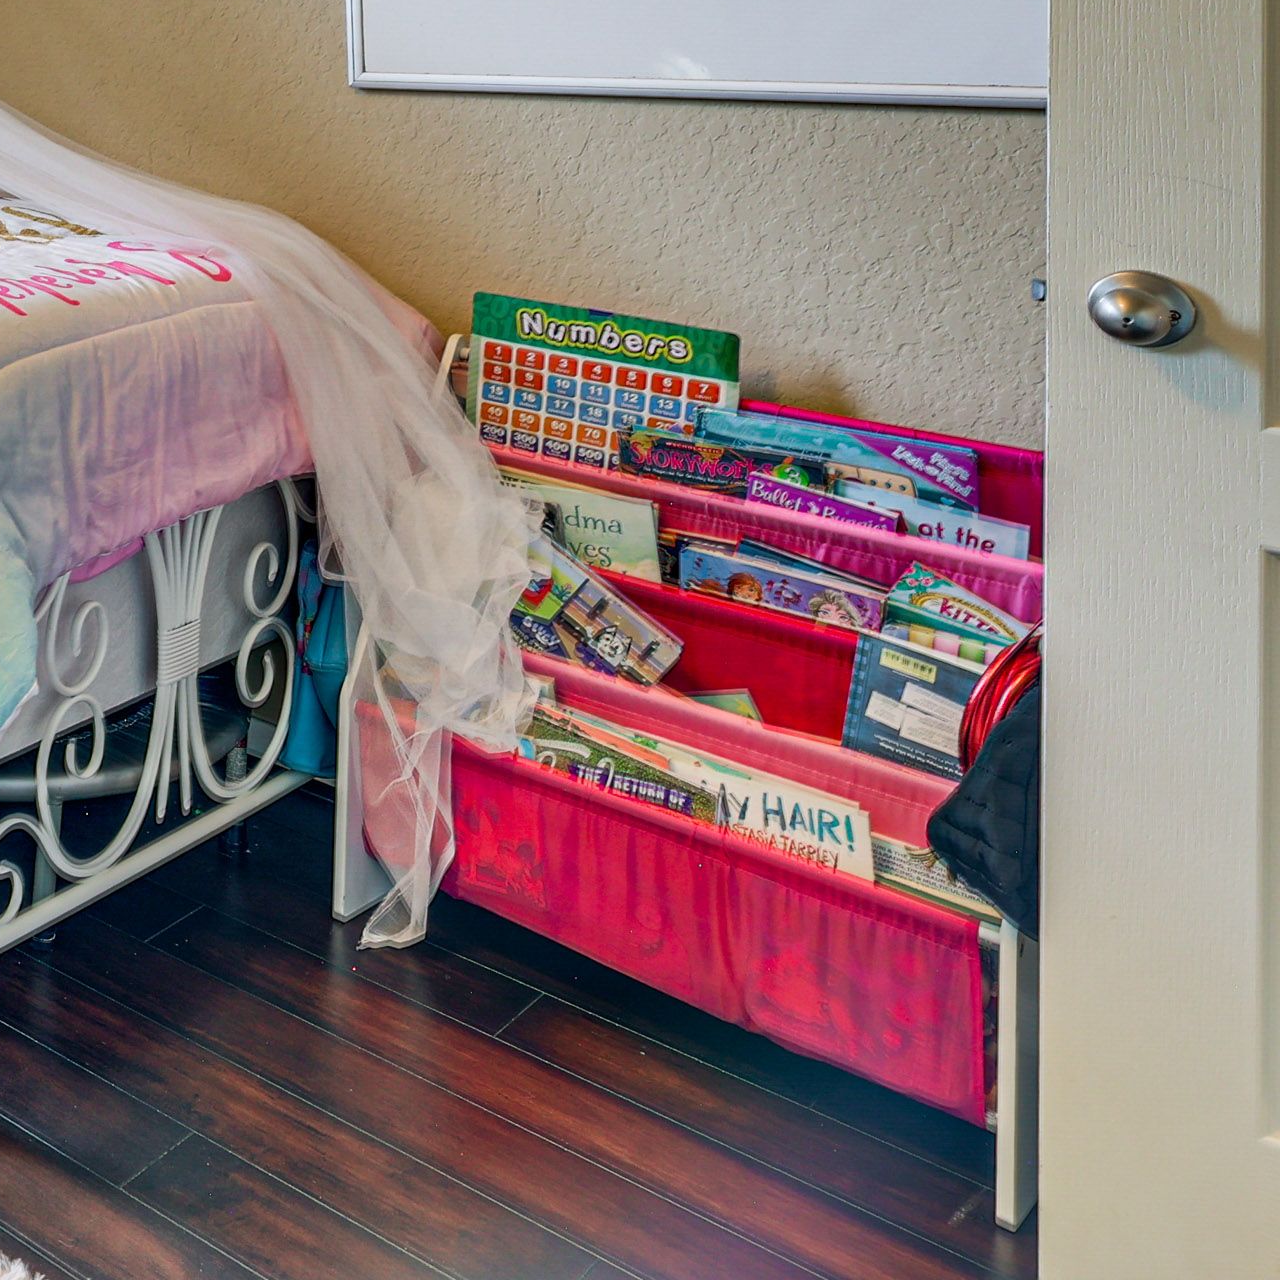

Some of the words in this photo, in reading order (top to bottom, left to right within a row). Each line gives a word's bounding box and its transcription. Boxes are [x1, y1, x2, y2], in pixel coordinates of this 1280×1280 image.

[518, 310, 691, 361] Numbers
[526, 352, 536, 362] 2
[699, 384, 710, 394] 7
[553, 399, 569, 409] 17
[621, 392, 639, 403] 12
[657, 399, 674, 410] 13
[482, 424, 506, 437] 200
[513, 431, 537, 444] 300
[545, 440, 569, 453] 400
[577, 448, 603, 461] 500
[750, 478, 804, 513] Ballet
[564, 505, 624, 535] dma
[917, 521, 945, 540] at
[955, 526, 997, 554] the
[576, 763, 603, 786] THE
[613, 774, 667, 802] RETURN
[668, 788, 689, 809] OF
[762, 791, 855, 852] HAIR!
[780, 833, 840, 874] TARPLEY
